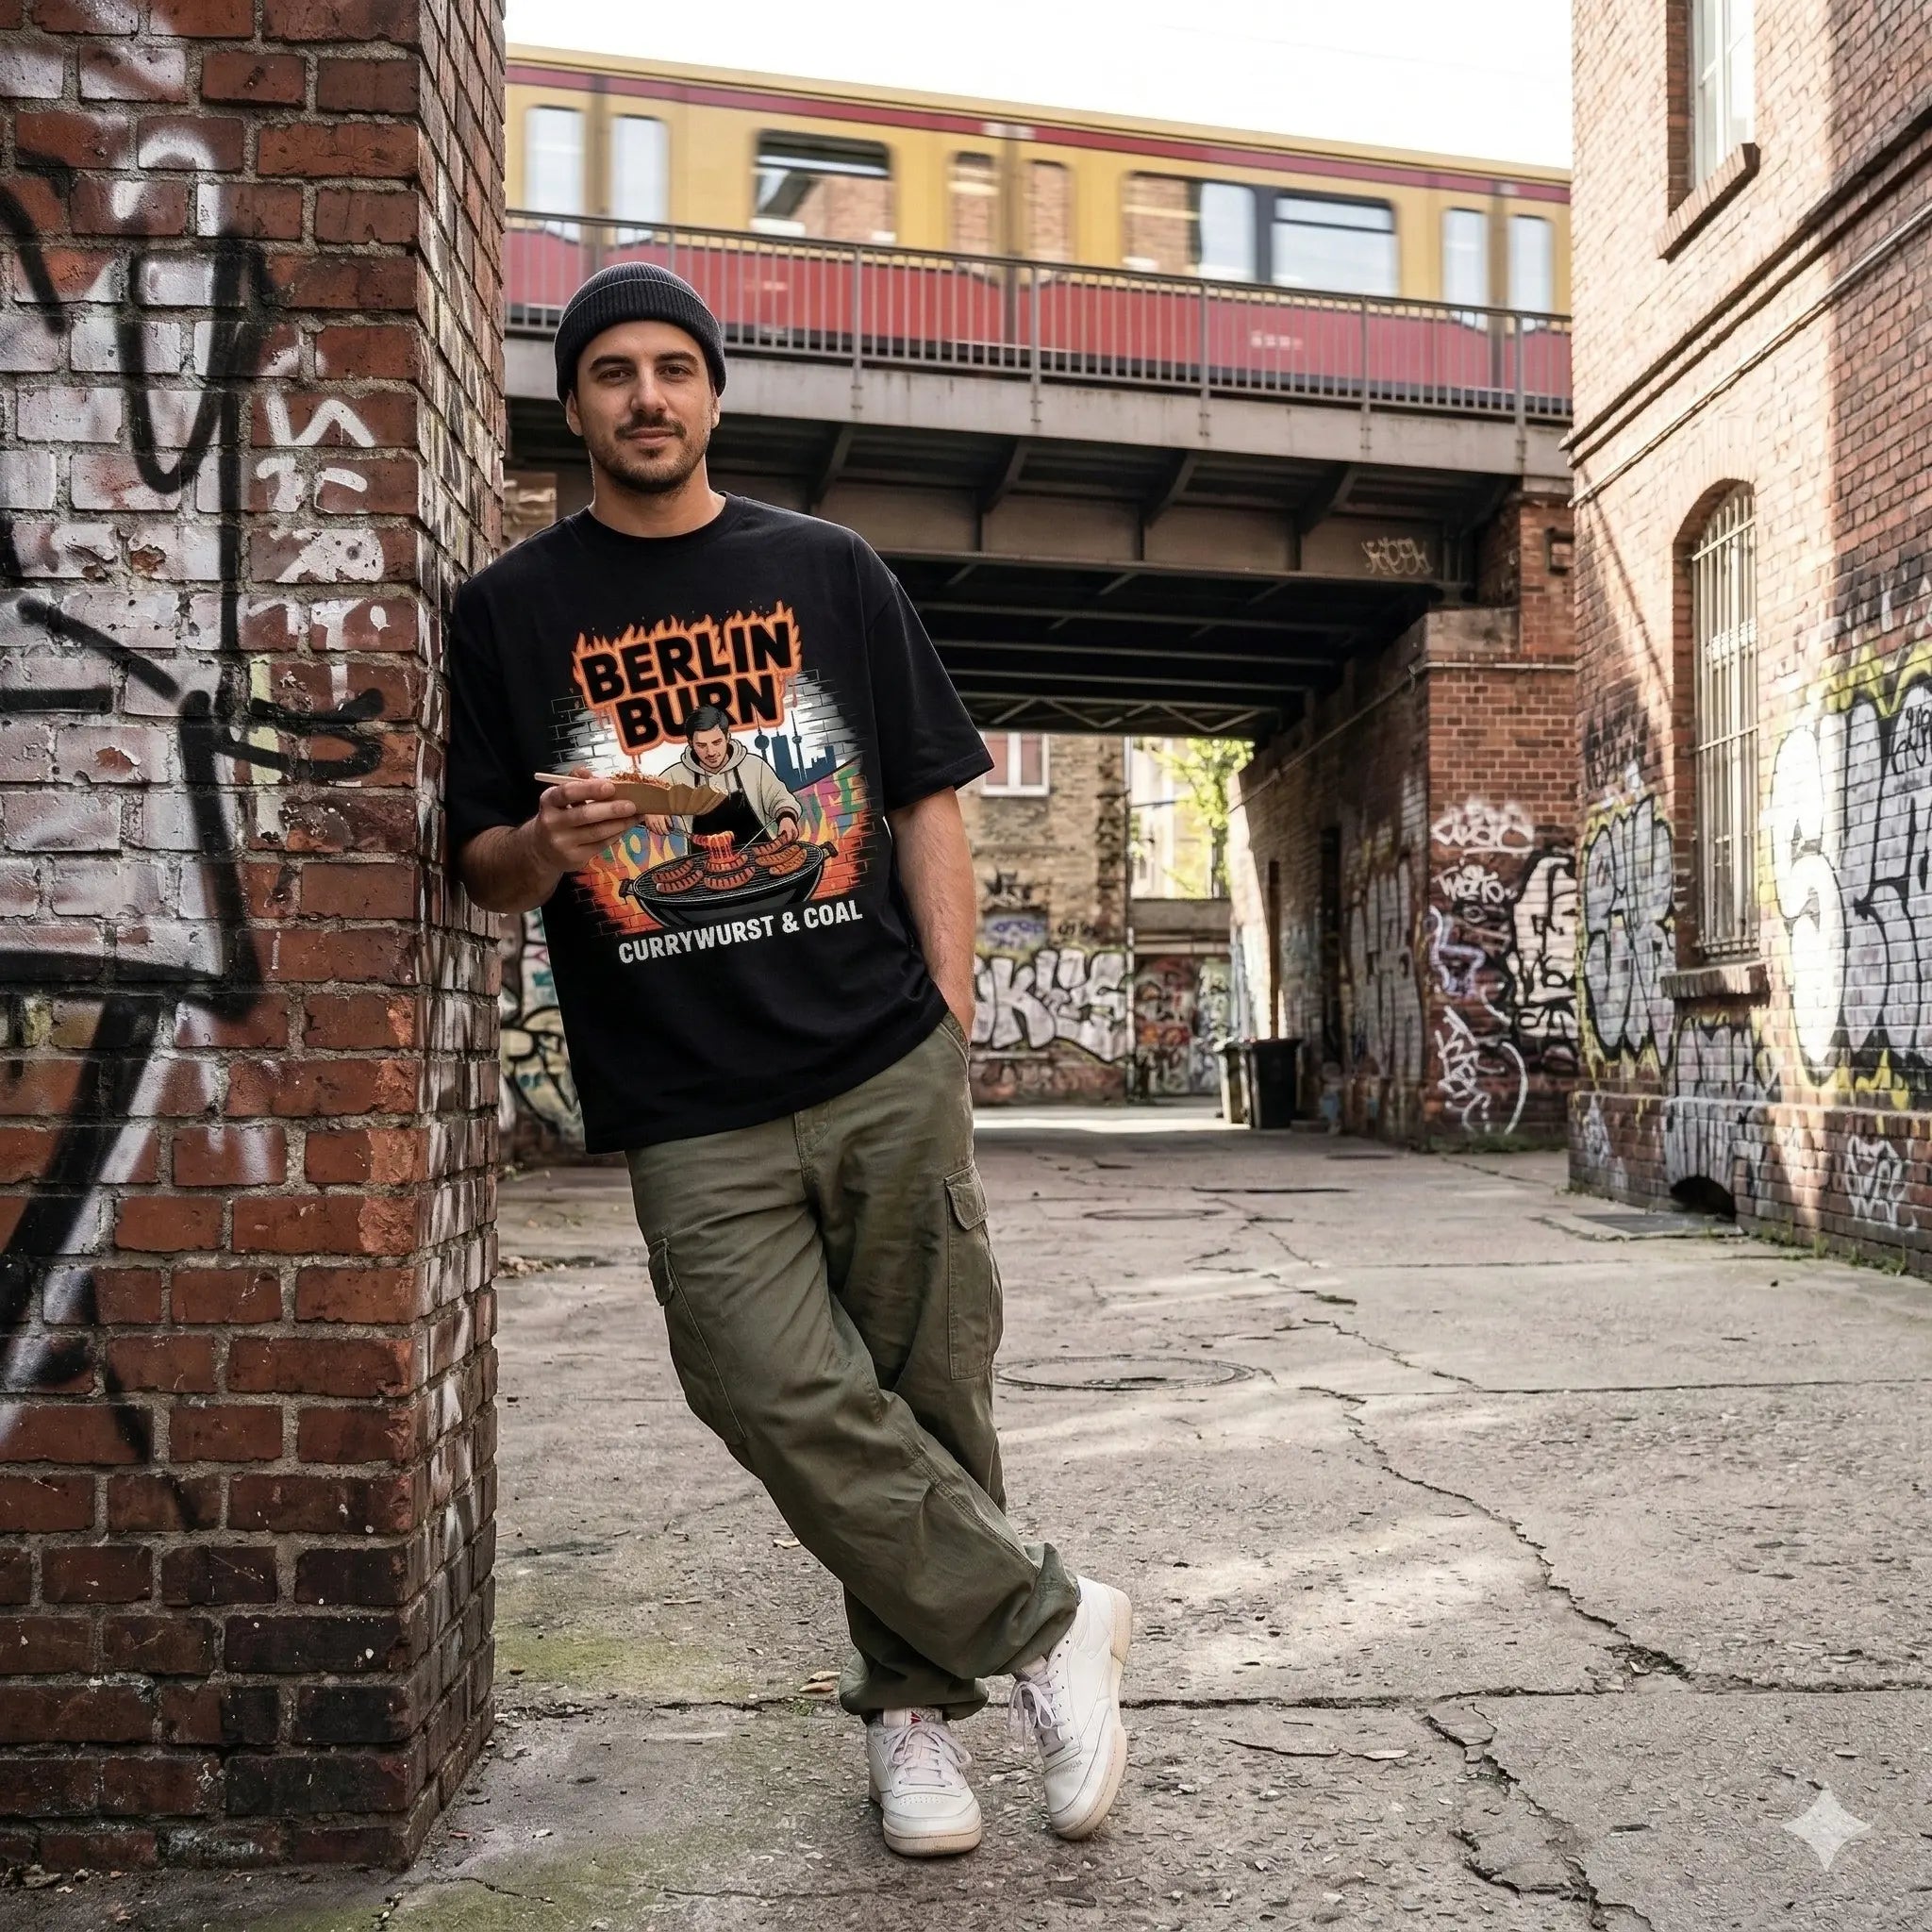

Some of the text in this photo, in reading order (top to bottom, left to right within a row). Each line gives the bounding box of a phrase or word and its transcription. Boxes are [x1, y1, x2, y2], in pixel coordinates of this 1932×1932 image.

[580, 622, 792, 704] BERLIN
[618, 900, 863, 964] CURRYWURST & COAL
